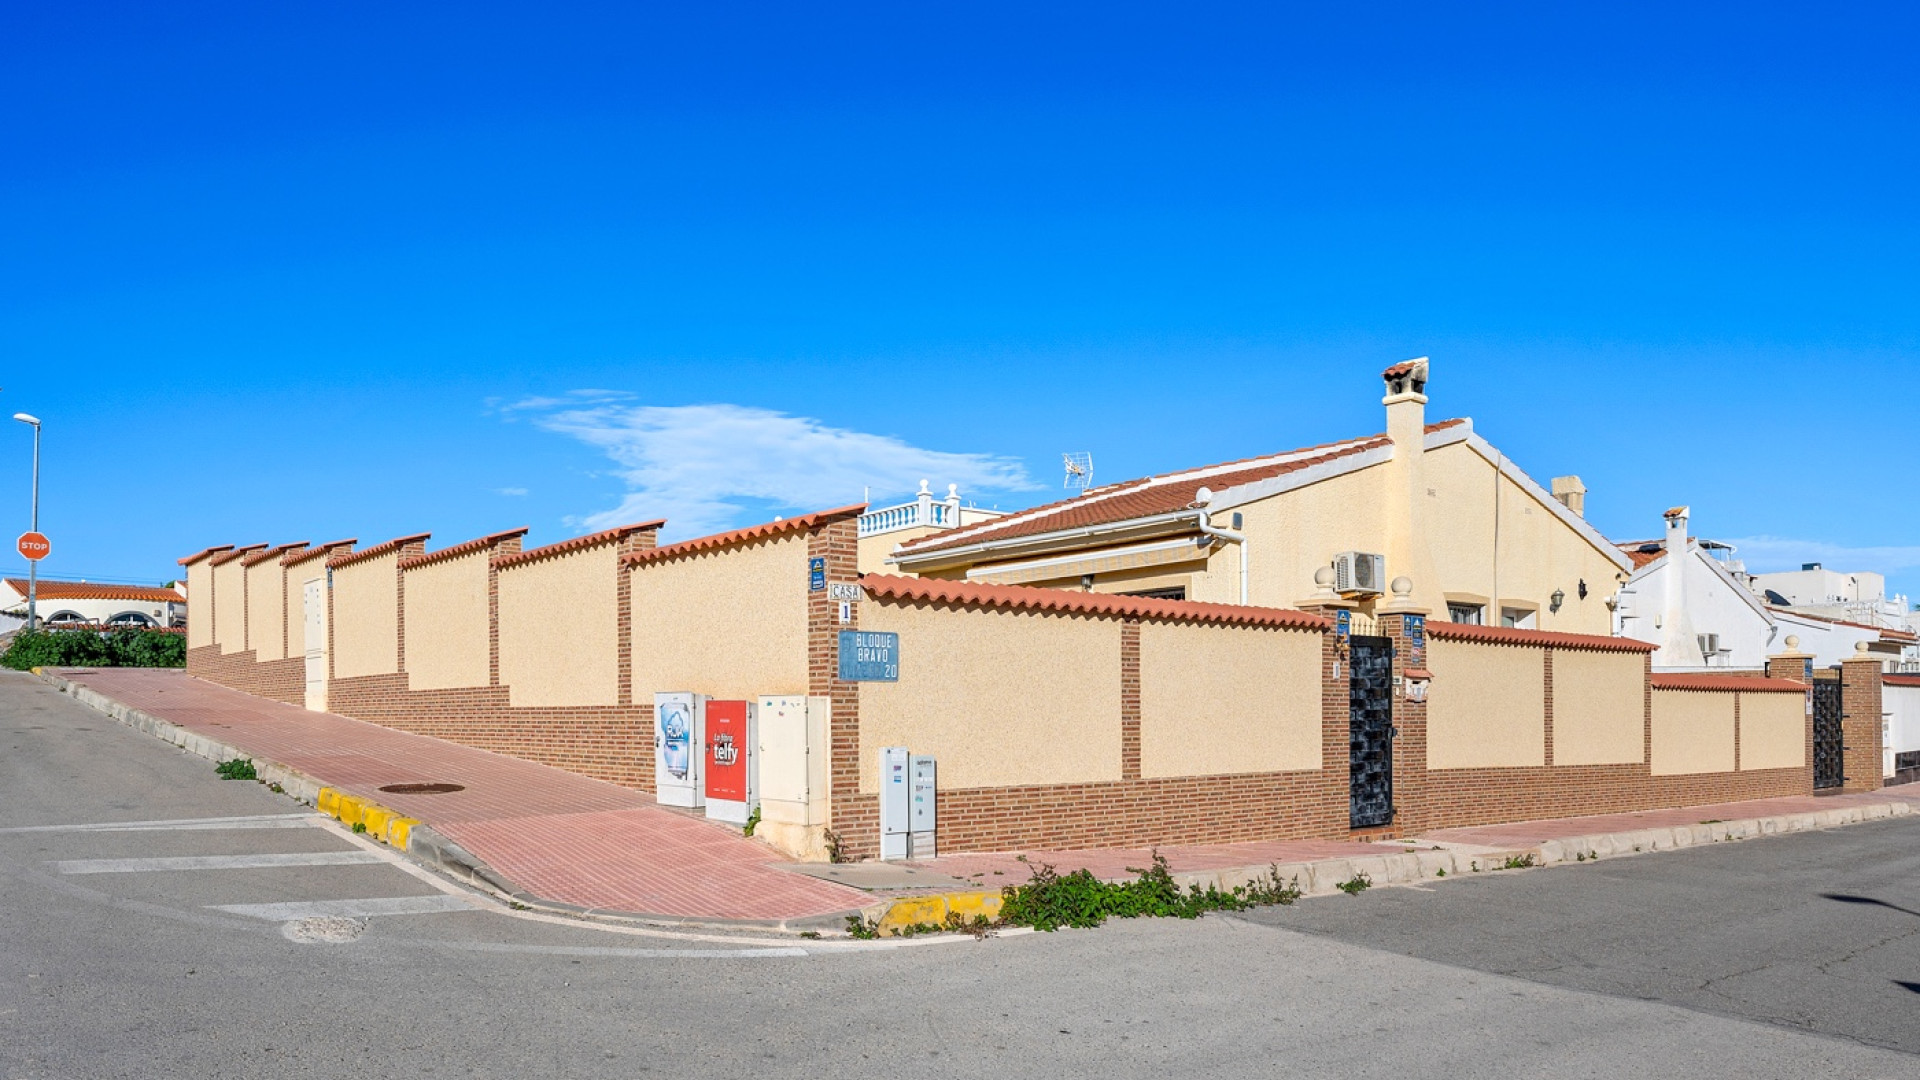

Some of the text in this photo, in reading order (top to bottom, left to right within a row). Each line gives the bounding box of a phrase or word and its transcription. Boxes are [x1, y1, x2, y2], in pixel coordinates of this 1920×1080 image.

[21, 542, 47, 550] STOP
[834, 585, 858, 598] CASA
[843, 605, 849, 618] 1
[856, 633, 892, 648] BLOQUE
[858, 648, 888, 663] BRAVO
[885, 664, 897, 678] 20
[714, 743, 738, 764] telfy
